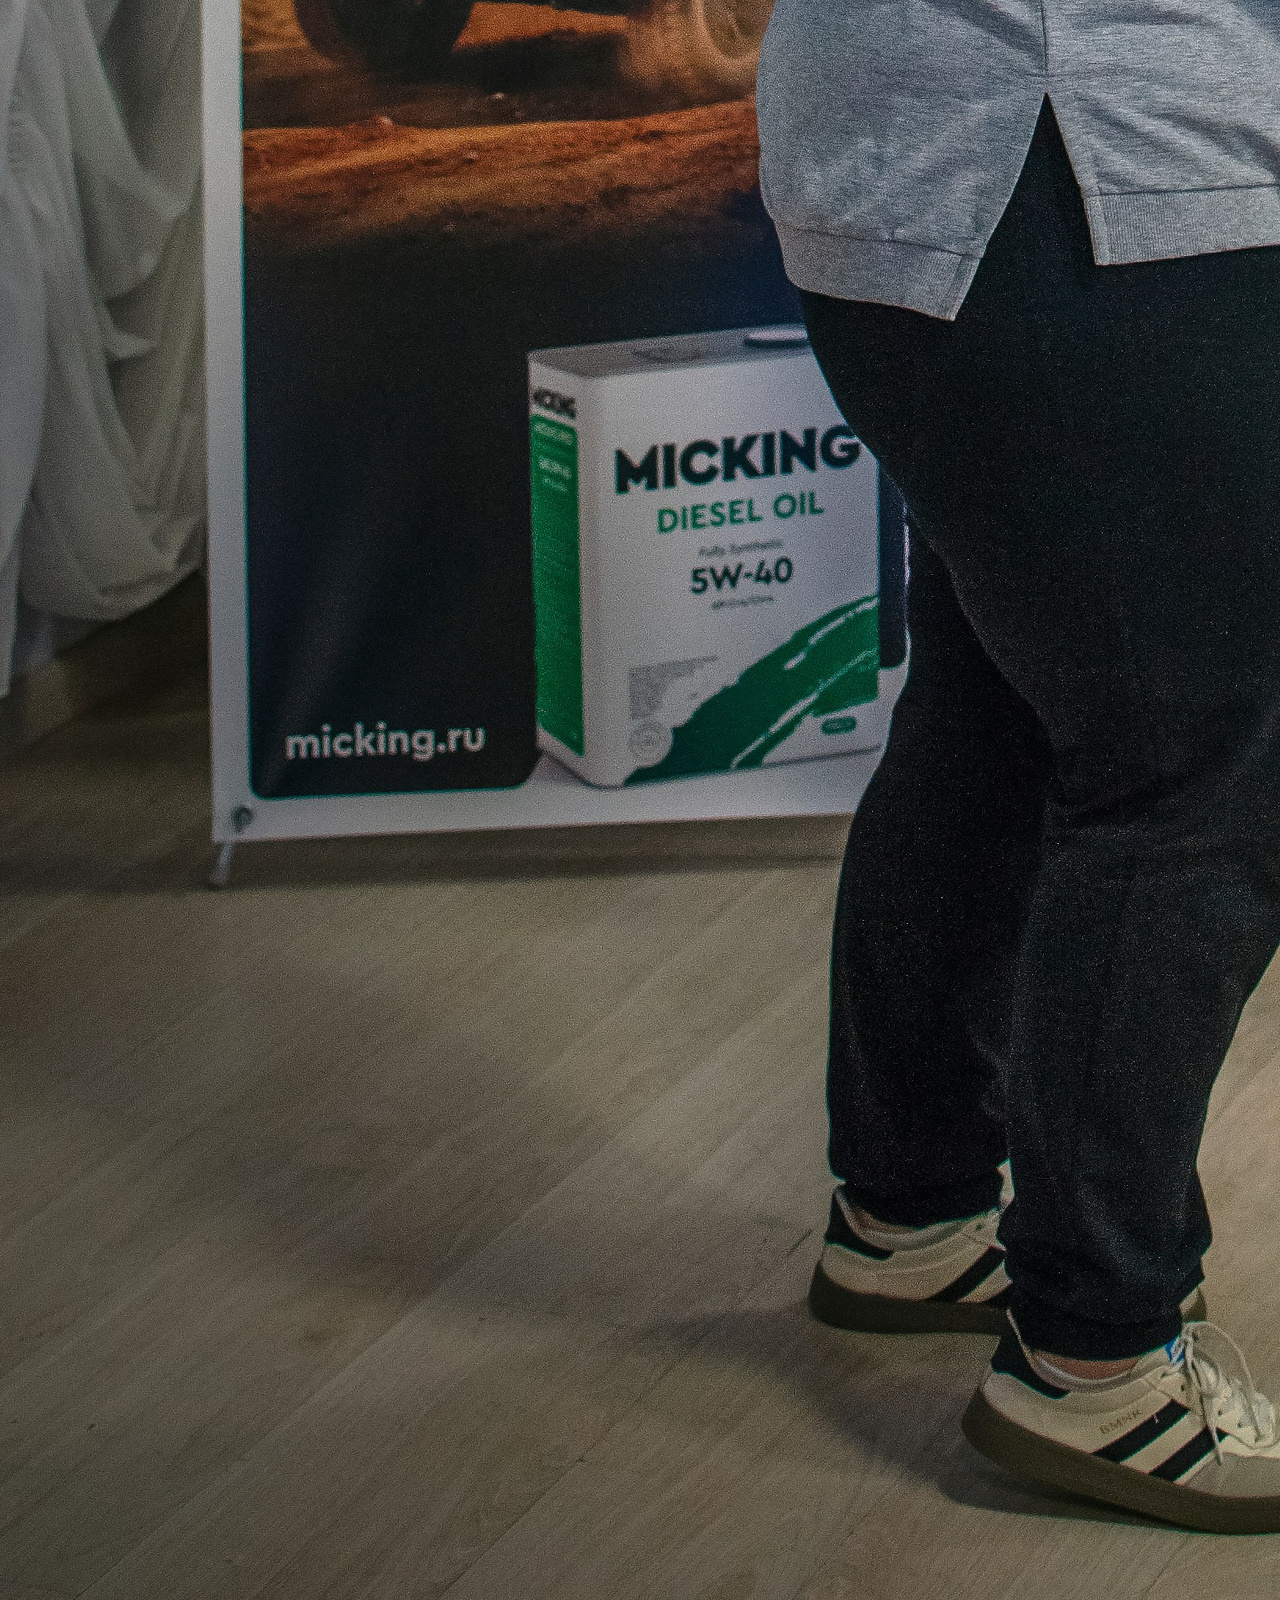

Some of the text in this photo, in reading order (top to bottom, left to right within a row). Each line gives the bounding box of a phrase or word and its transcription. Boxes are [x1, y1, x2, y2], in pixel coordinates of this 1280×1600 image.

[615, 425, 861, 495] MICKING
[657, 491, 825, 534] DIESEL OIL
[690, 556, 793, 595] 5W-40
[285, 721, 486, 762] micking.ru
